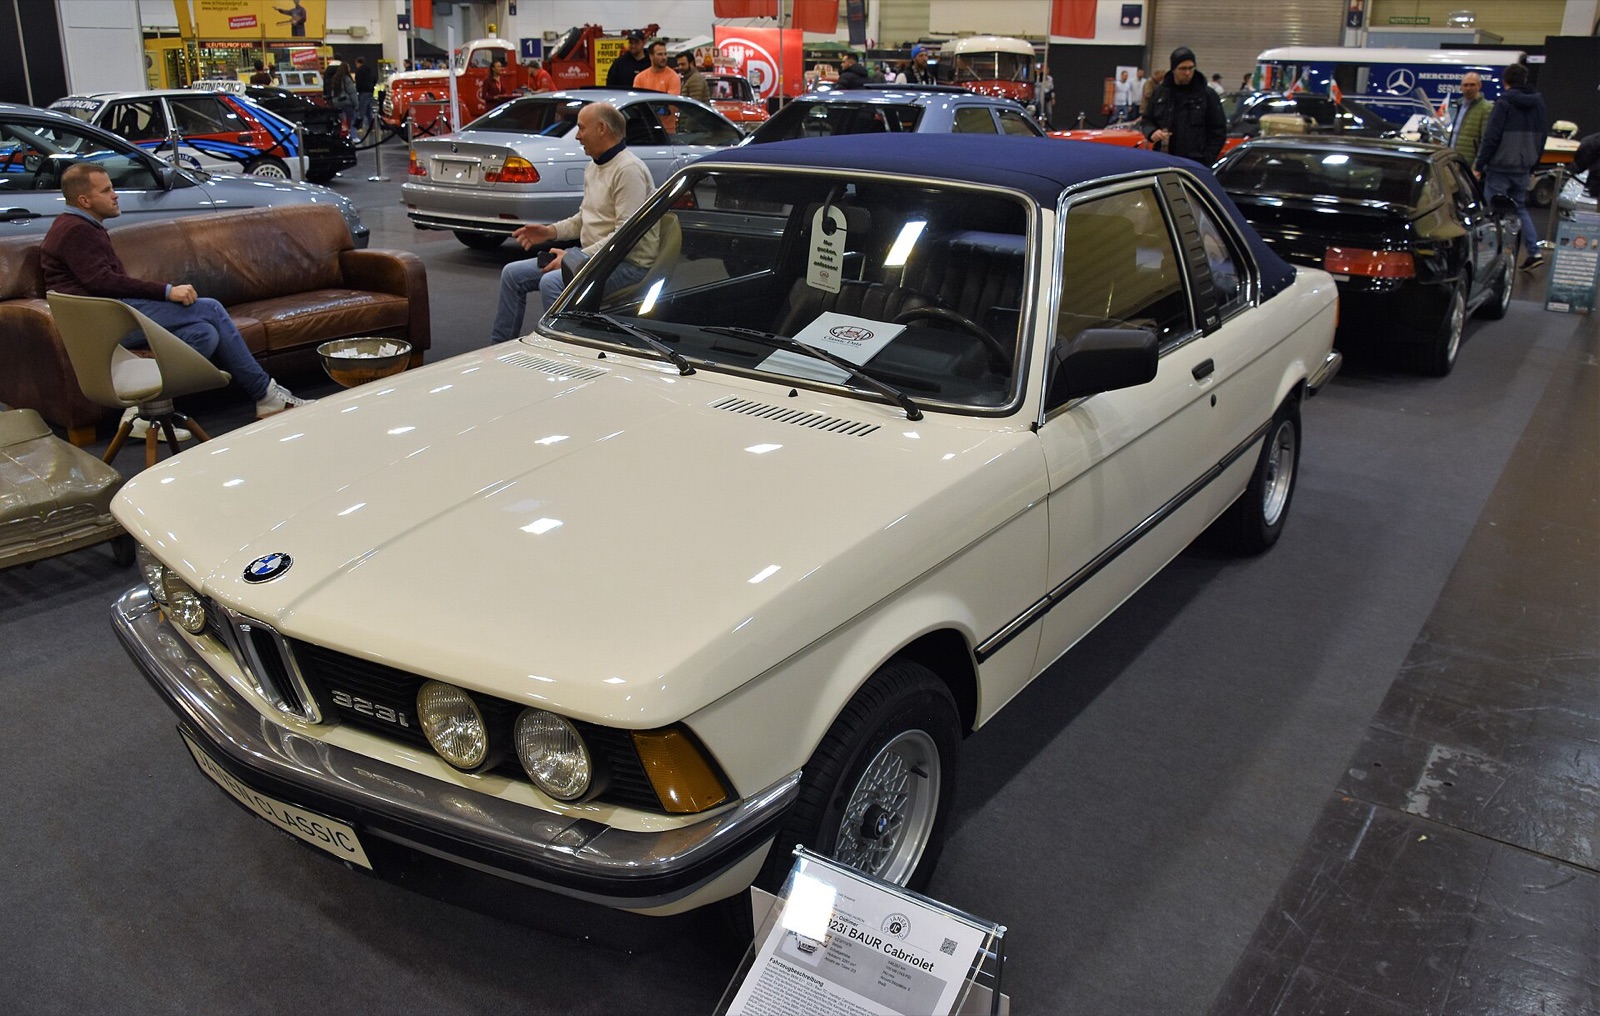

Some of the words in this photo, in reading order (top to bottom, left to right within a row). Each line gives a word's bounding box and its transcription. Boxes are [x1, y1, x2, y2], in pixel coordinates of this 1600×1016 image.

[526, 40, 534, 54] 1
[215, 82, 241, 93] RACING
[73, 101, 100, 110] RACING
[820, 254, 833, 262] nicht
[332, 690, 409, 728] 323i
[254, 796, 355, 853] CLASSIC
[838, 915, 859, 927] Oldtimer
[890, 916, 907, 928] JANEN
[848, 928, 882, 949] BAUR
[883, 943, 935, 973] Cabriolet
[769, 957, 824, 987] Fahrzeugbeschreibung
